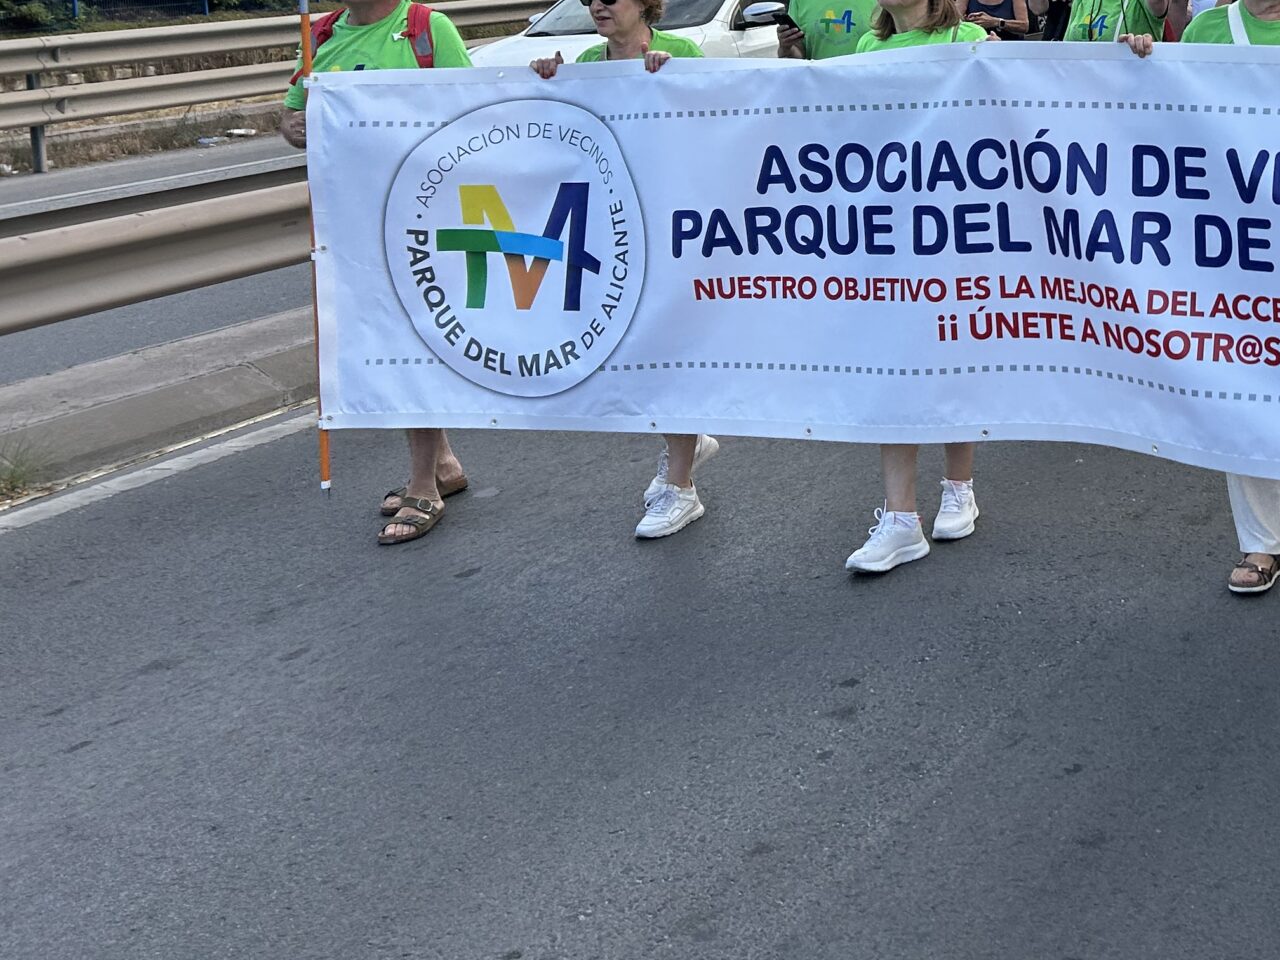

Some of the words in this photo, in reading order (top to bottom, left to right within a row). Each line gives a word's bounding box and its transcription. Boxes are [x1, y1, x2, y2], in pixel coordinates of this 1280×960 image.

[416, 124, 521, 208] ASOCIACIÓN
[527, 122, 553, 140] DE
[558, 125, 614, 185] VECINOS
[756, 129, 1107, 196] ASOCIACIÓN
[1132, 144, 1210, 201] DE
[672, 204, 896, 259] PARQUE
[913, 202, 1032, 256] DEL
[1043, 206, 1171, 266] MAR
[1194, 213, 1274, 273] DE
[406, 228, 466, 346] PARQUE
[463, 337, 511, 375] DEL
[518, 340, 581, 377] MAR
[580, 318, 605, 350] DE
[601, 200, 629, 320] ALICANTE
[694, 276, 817, 301] NUESTRO
[823, 276, 947, 302] OBJETIVO
[956, 275, 991, 301] ES
[999, 275, 1034, 299] LA
[1040, 277, 1139, 314] MEJORA
[1147, 290, 1204, 318] DEL
[969, 306, 1073, 342] ÚNETE
[1081, 317, 1098, 345] A
